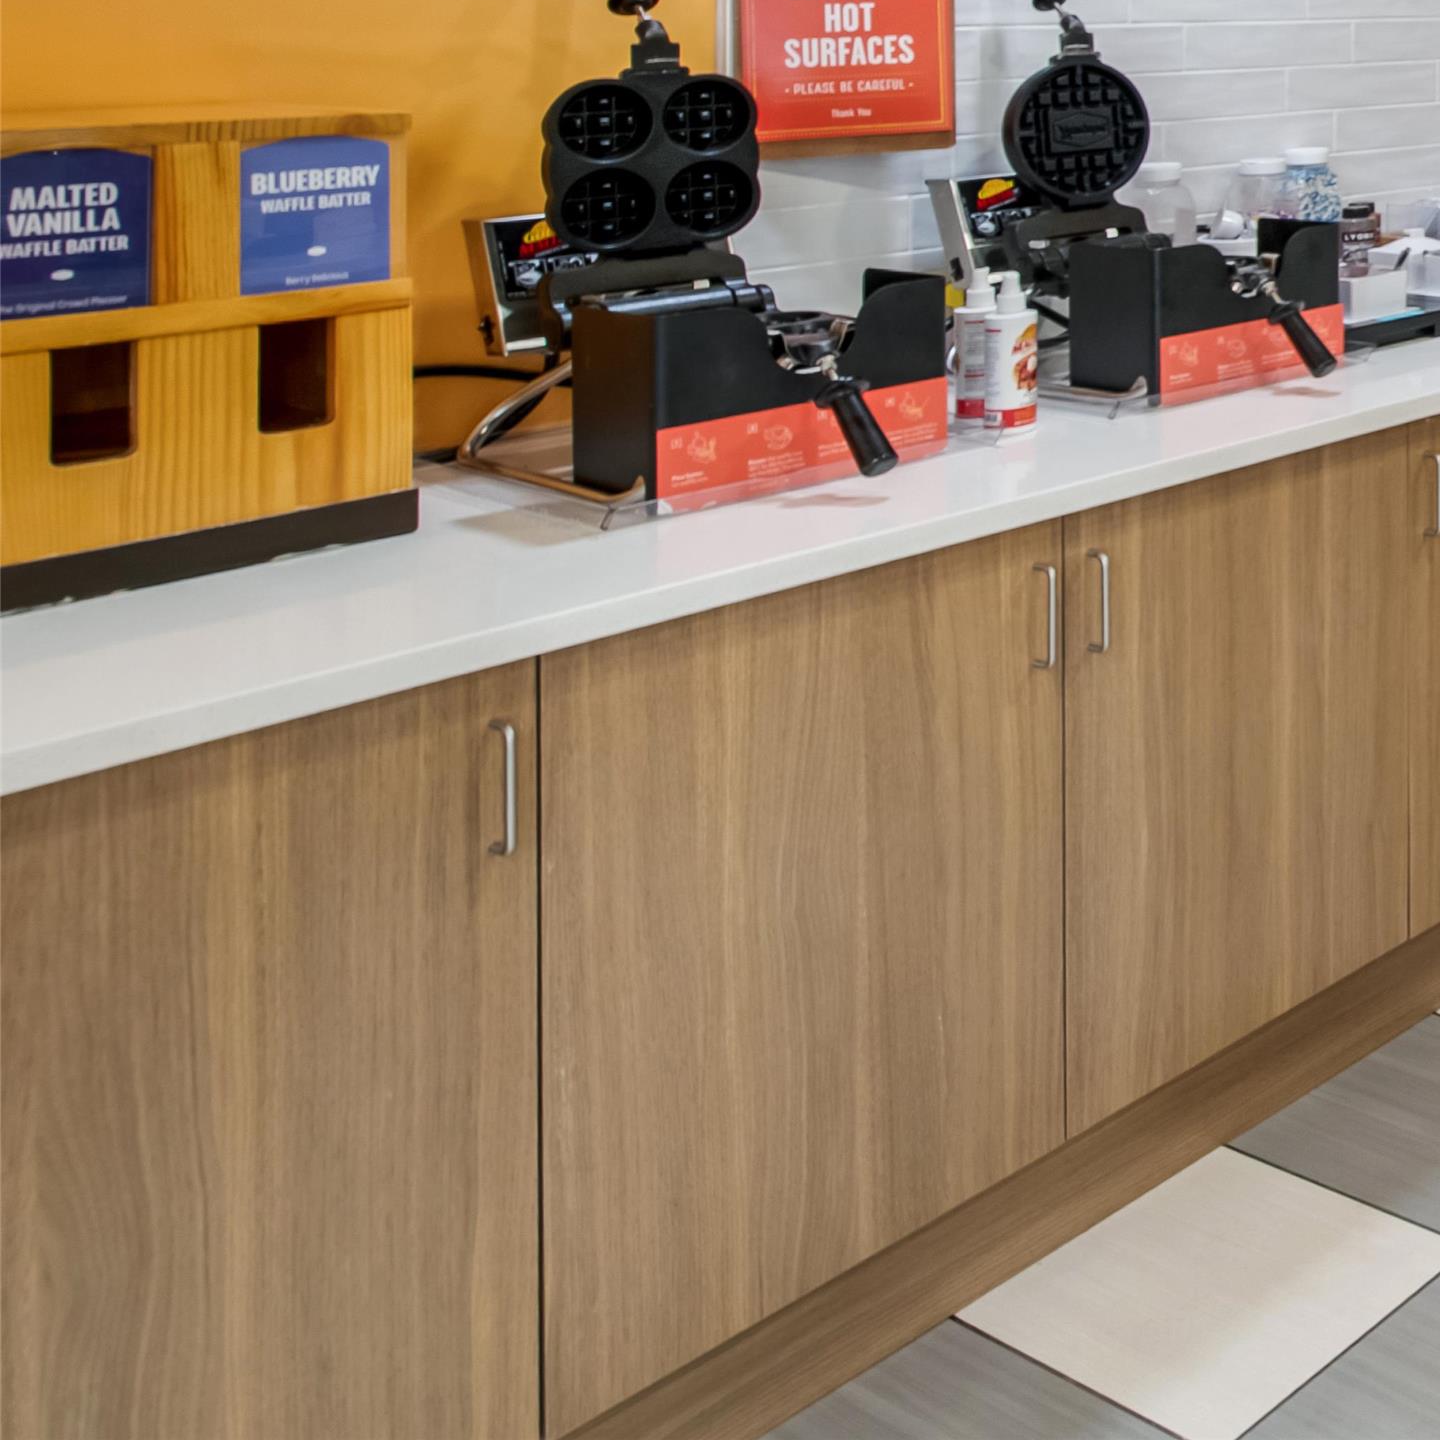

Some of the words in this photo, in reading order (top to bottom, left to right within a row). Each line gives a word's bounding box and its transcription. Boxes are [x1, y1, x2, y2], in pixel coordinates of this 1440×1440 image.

[823, 2, 876, 33] HOT
[783, 35, 915, 68] SURFACES
[793, 81, 835, 95] PLEASE
[839, 80, 853, 93] BE
[857, 78, 905, 92] CAREFUL
[831, 108, 854, 118] Thank
[856, 107, 872, 117] You
[250, 163, 380, 196] BLUEBERRY
[9, 181, 119, 212] MALTED
[260, 195, 316, 214] WAFFLE
[318, 191, 371, 209] BATTER
[6, 207, 121, 238] VANILLA
[65, 234, 129, 255] BATTER
